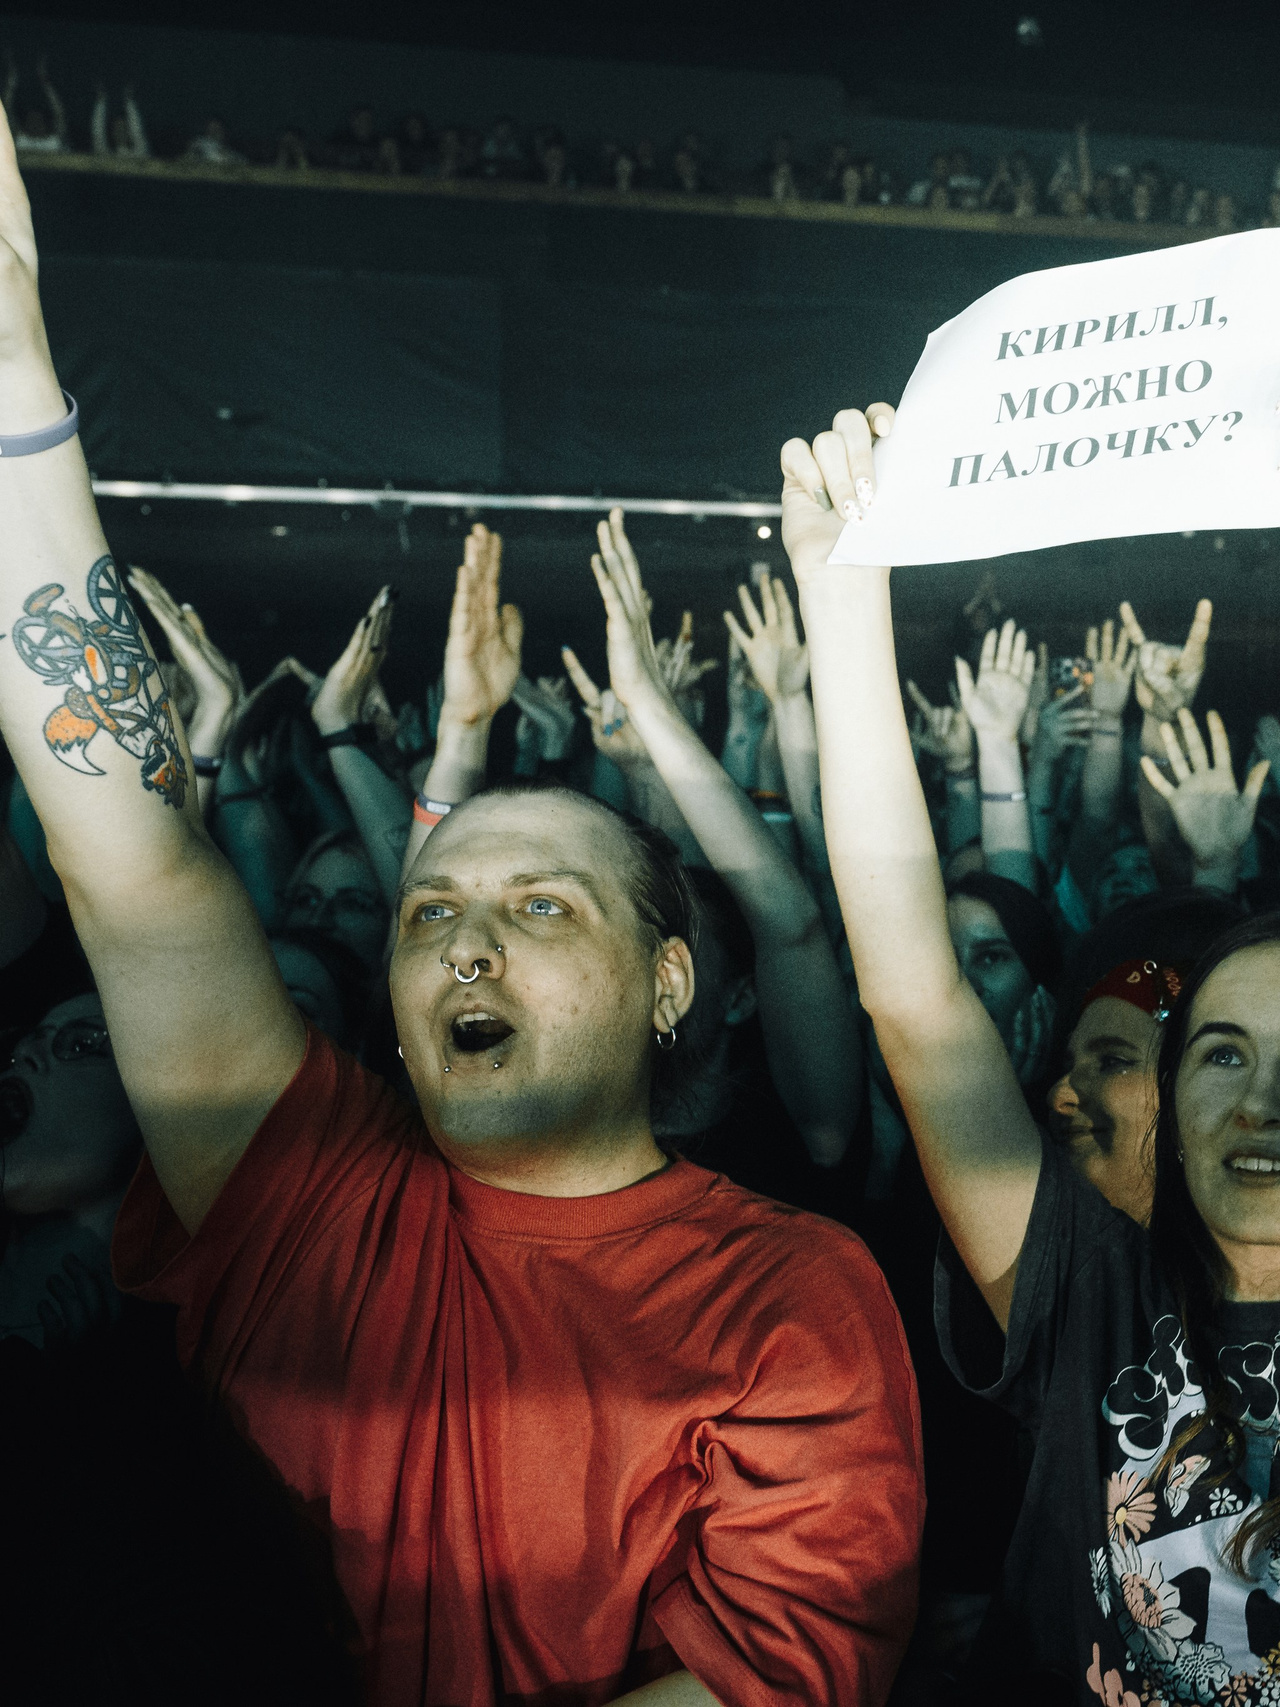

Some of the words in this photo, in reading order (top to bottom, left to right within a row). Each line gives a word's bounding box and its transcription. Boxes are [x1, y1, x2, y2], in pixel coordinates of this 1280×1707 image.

[996, 296, 1228, 360] КИРИЛЛ,
[996, 360, 1212, 423] МОЖНО
[949, 411, 1243, 487] ПАЛОЧКУ?
